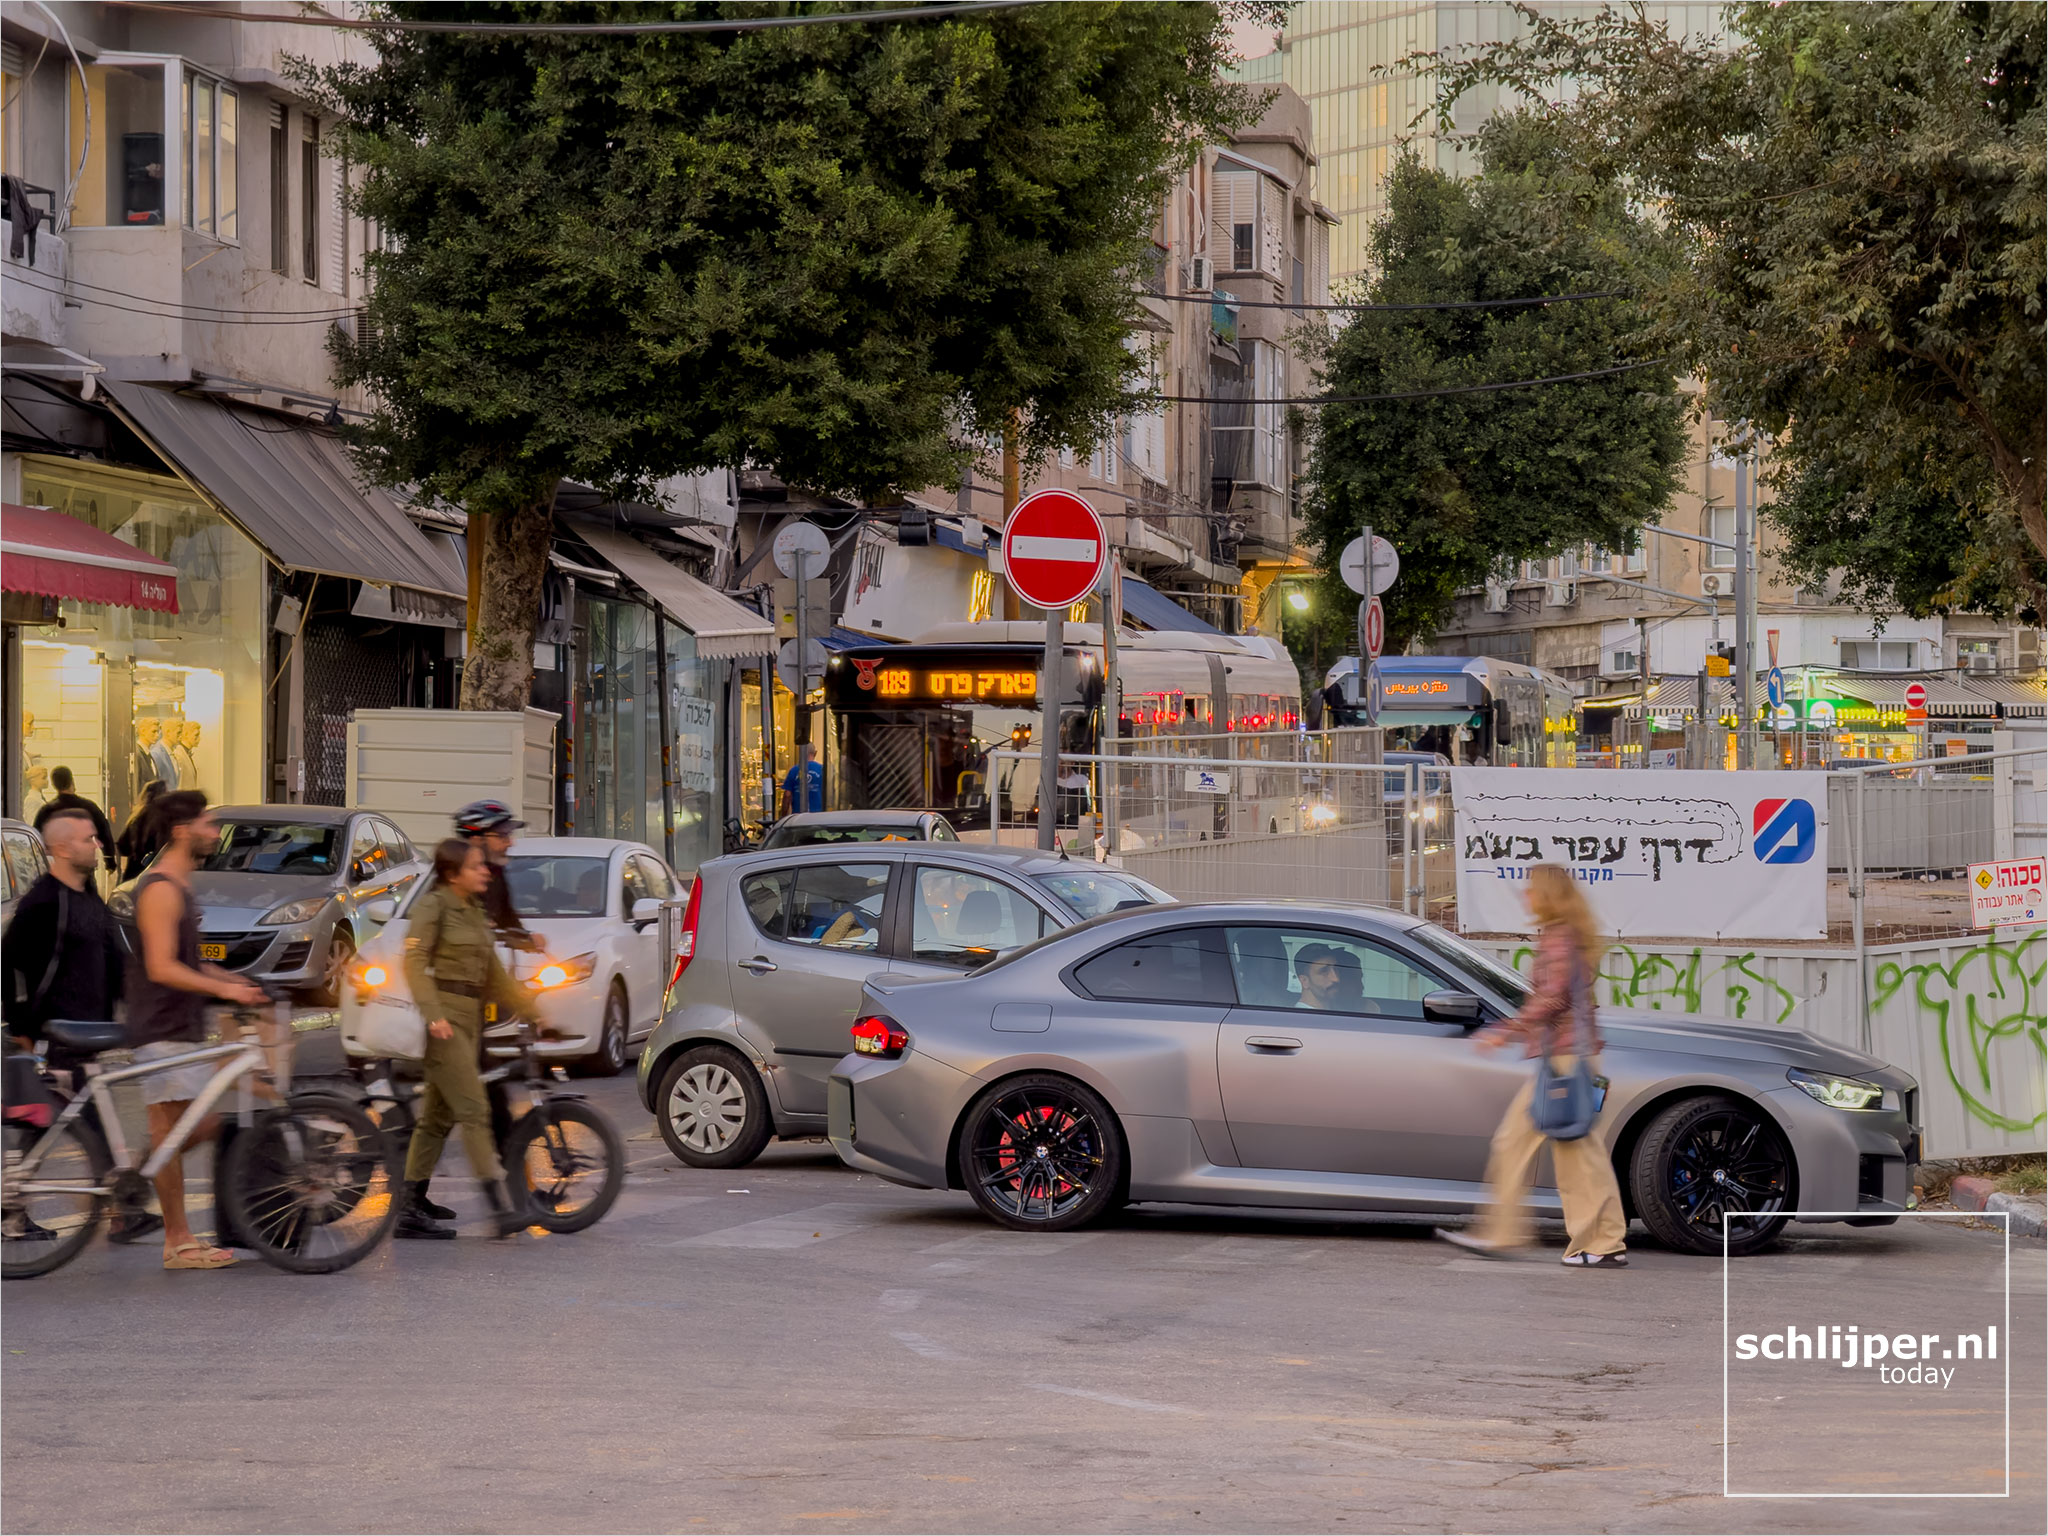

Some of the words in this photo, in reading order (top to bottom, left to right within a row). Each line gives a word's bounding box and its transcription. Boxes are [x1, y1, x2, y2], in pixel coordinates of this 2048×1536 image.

[141, 581, 149, 598] 14
[878, 671, 911, 695] 189
[930, 673, 973, 694] פרס
[977, 673, 1037, 695] פארק
[1552, 836, 1627, 864] עפר
[1640, 837, 1714, 881] דרך
[1996, 864, 2042, 888] סכנה!
[1977, 896, 2002, 909] עבודה
[2005, 893, 2024, 906] אתר
